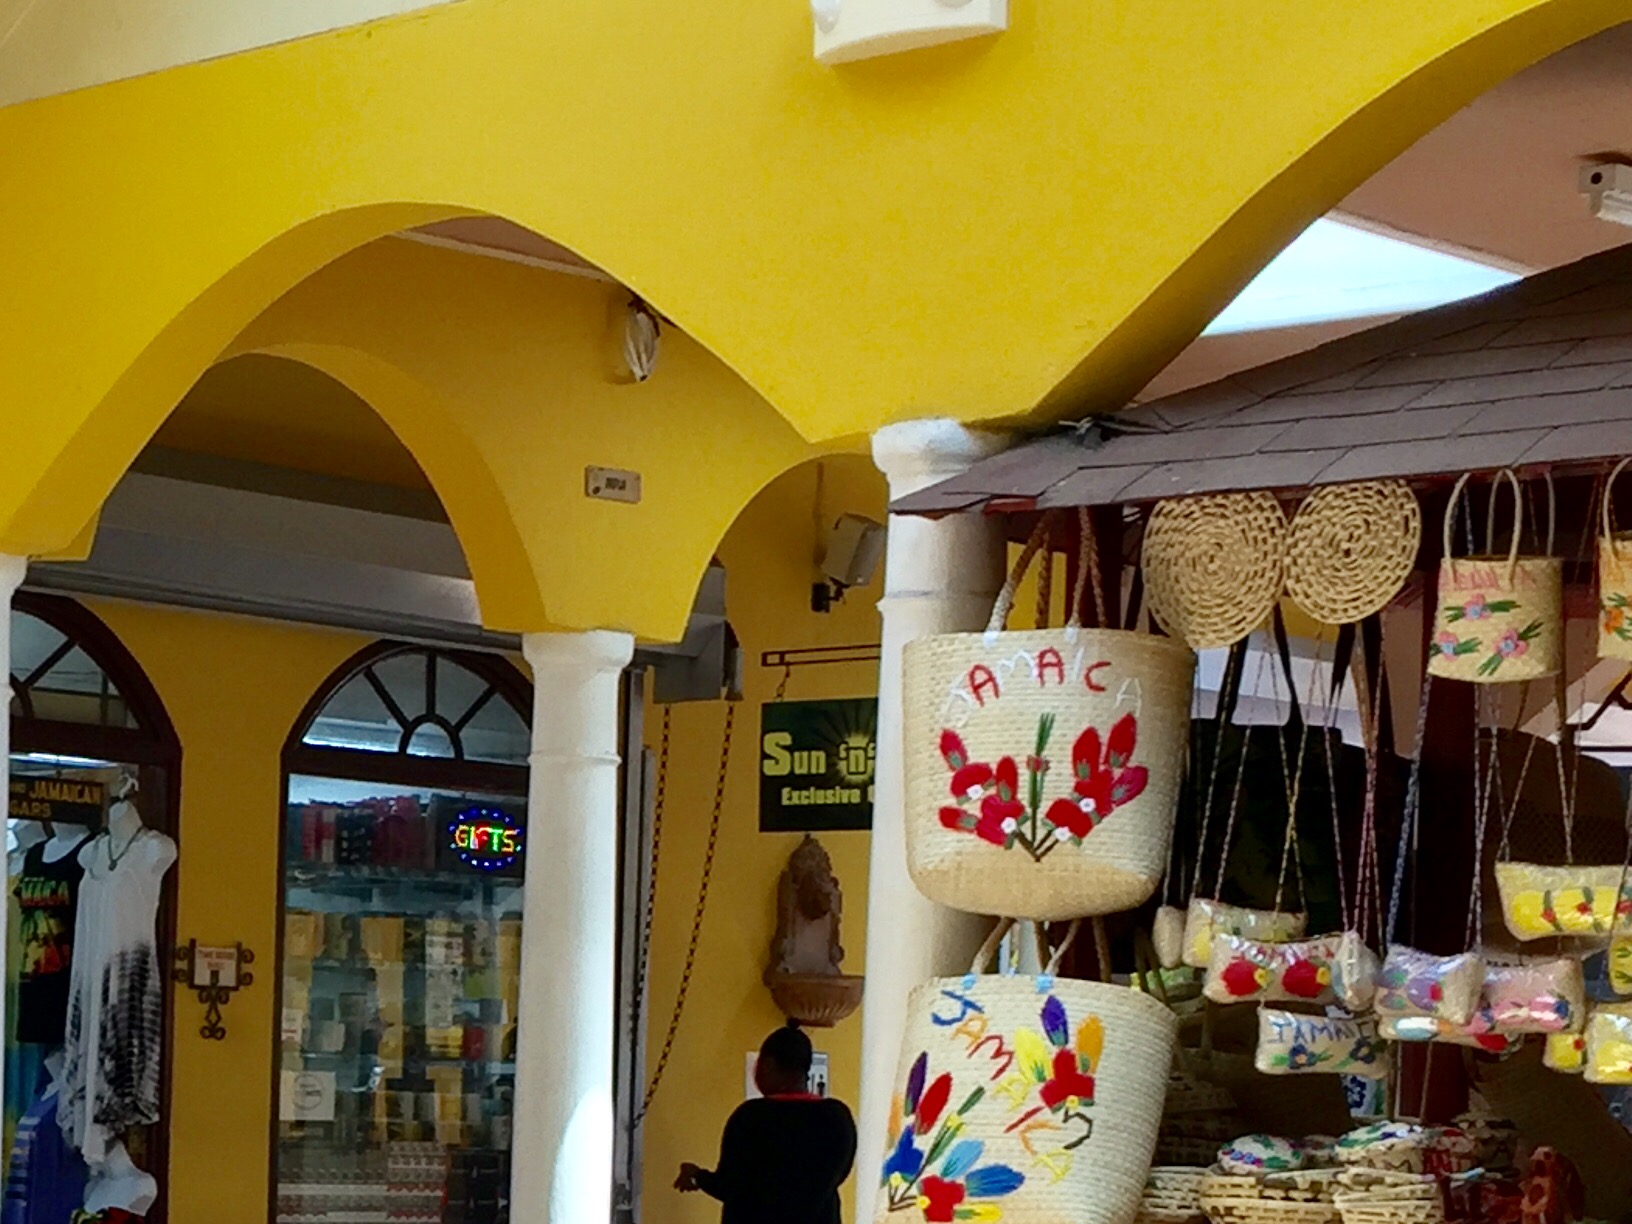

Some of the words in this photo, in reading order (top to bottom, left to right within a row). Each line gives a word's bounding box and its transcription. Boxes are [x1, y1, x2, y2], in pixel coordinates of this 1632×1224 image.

[936, 645, 1143, 729] JAMAICA
[762, 731, 827, 777] Sun
[28, 780, 104, 805] JAMAICAN
[781, 785, 861, 806] Exclusive
[10, 801, 51, 818] GARS
[455, 824, 518, 853] GIFTS
[1267, 1013, 1374, 1043] JAMAIC
